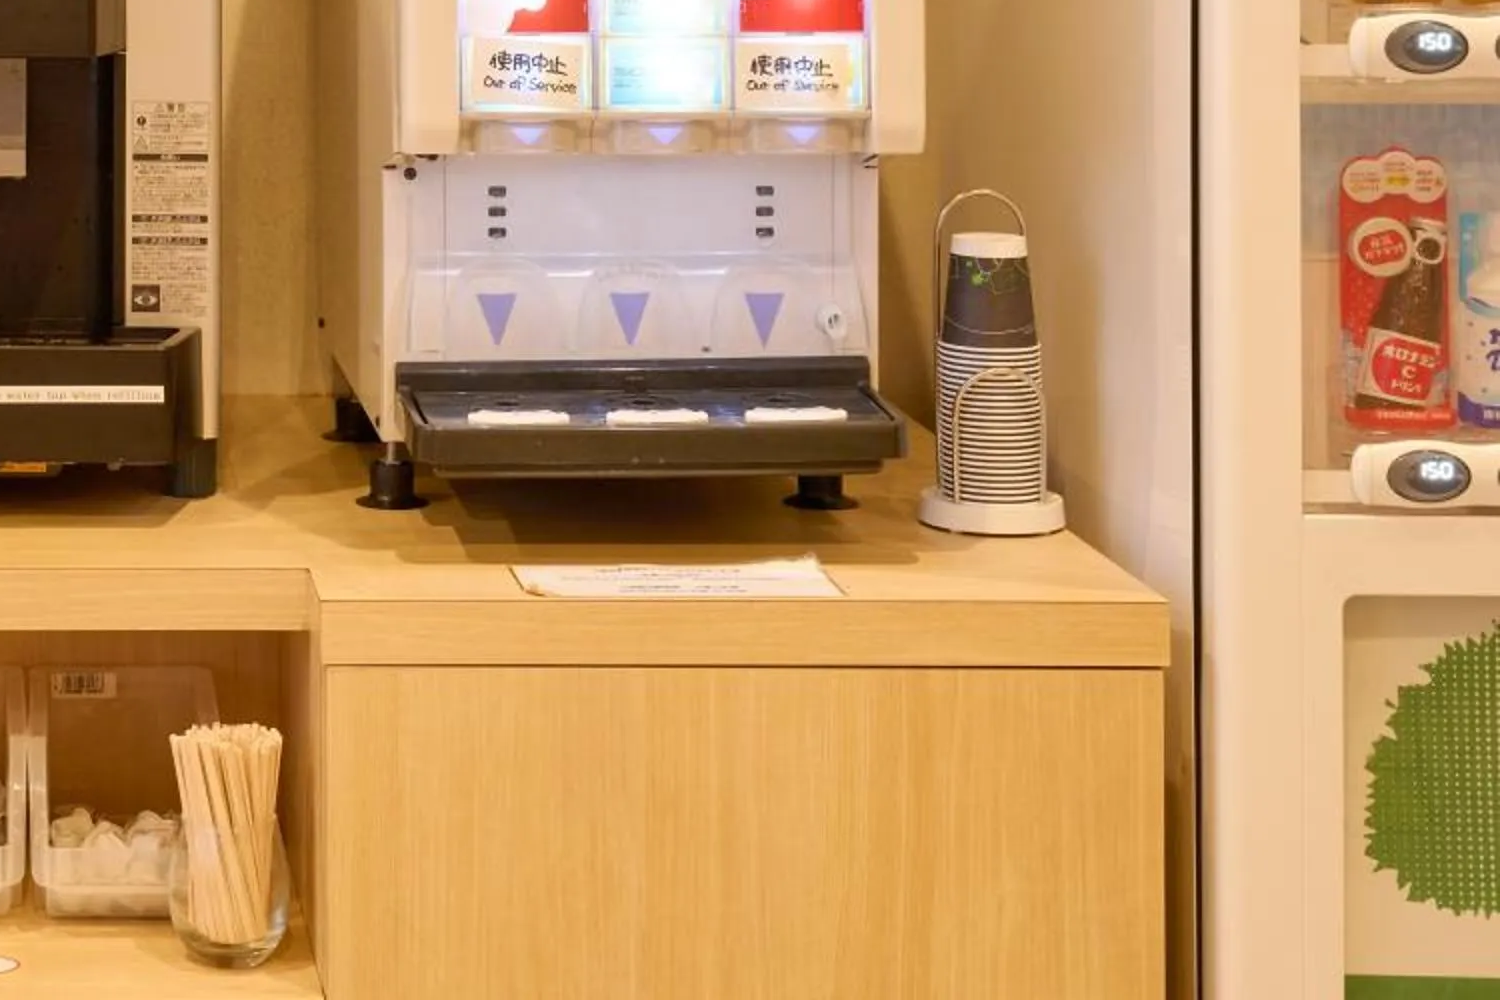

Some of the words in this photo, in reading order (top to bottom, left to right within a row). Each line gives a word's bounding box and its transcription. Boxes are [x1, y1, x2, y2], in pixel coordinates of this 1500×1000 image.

[1418, 32, 1453, 52] 150
[488, 50, 568, 76] 使用中止
[749, 55, 834, 77] 使用中止
[483, 75, 506, 88] Out
[509, 75, 527, 91] of
[527, 77, 578, 95] Service
[746, 80, 768, 91] Out
[773, 79, 790, 91] of
[1420, 461, 1454, 480] 150
